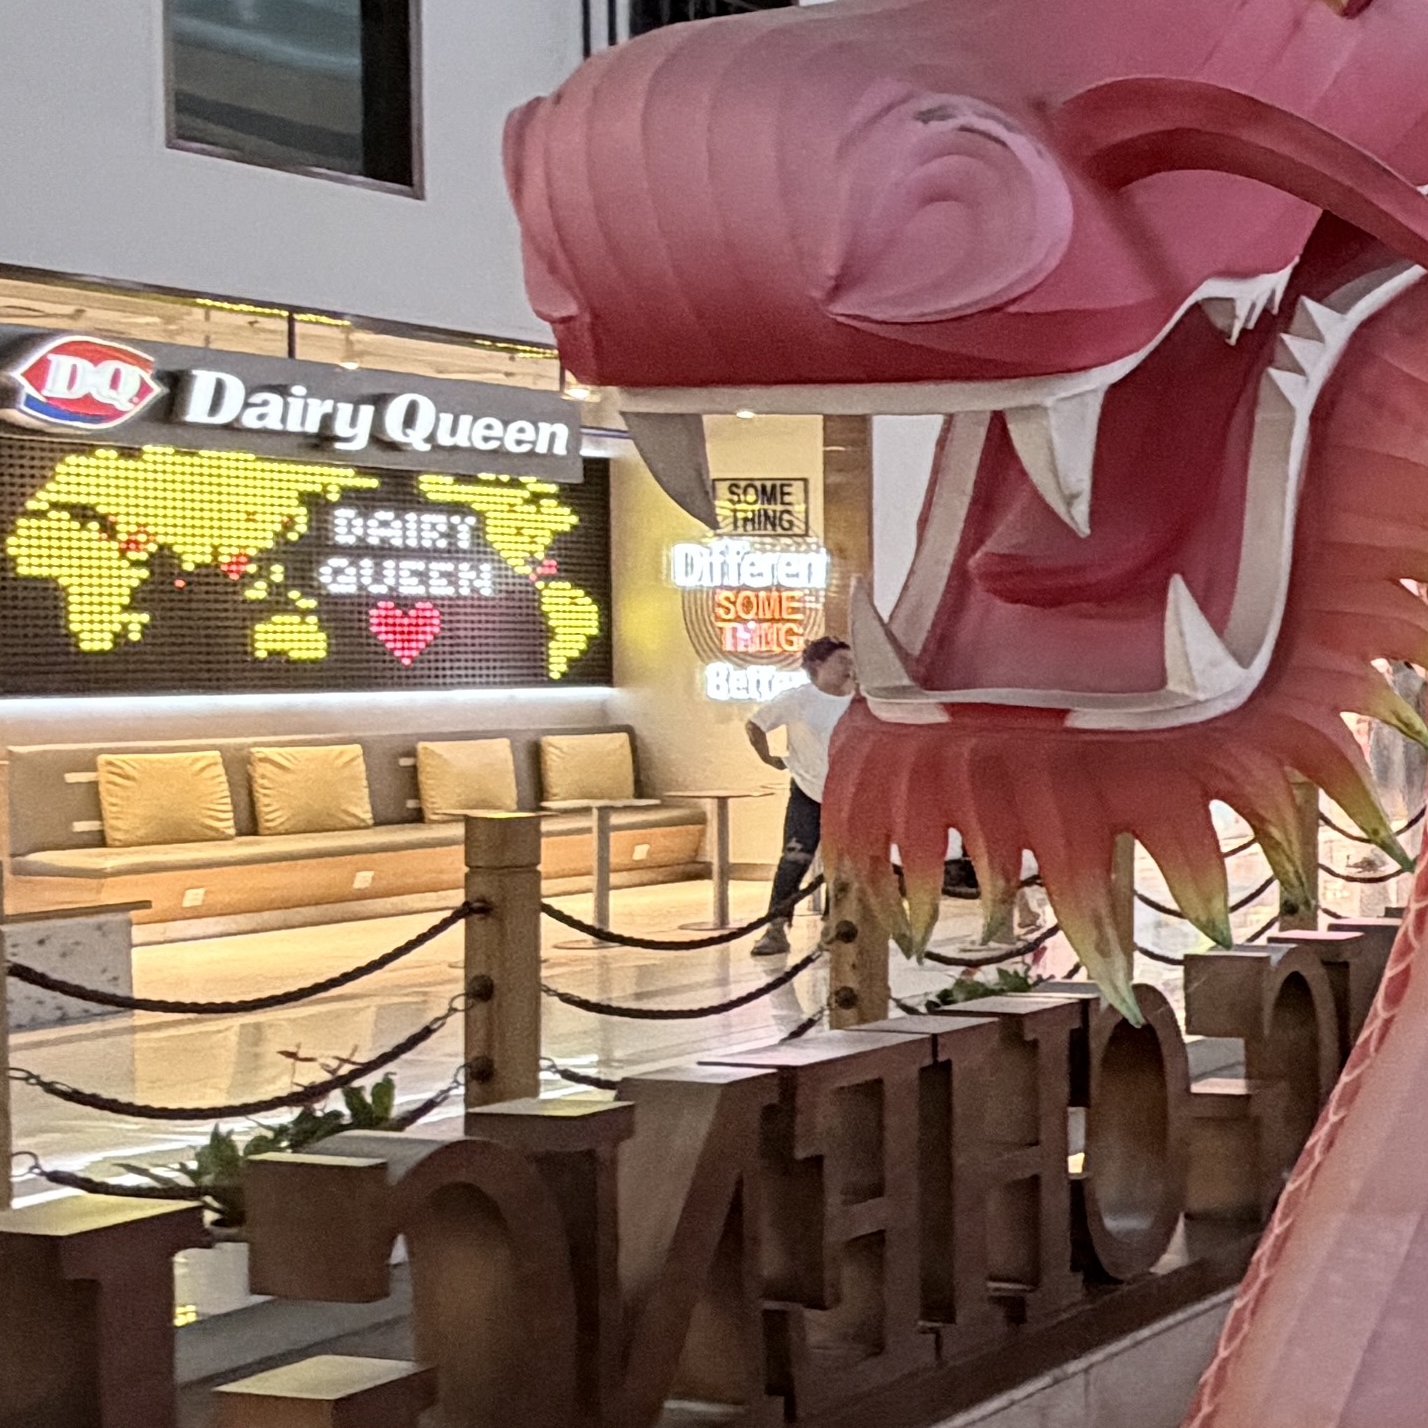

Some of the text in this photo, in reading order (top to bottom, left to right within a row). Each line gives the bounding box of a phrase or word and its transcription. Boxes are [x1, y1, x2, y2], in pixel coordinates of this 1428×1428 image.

[47, 353, 141, 412] DQ
[185, 369, 569, 456] Dairy Queen
[728, 483, 793, 506] SOME
[332, 508, 476, 549] DAIRY
[728, 508, 795, 532] THING
[319, 558, 494, 598] QUEEN
[716, 590, 804, 620] SOME
[716, 621, 804, 651] THING
